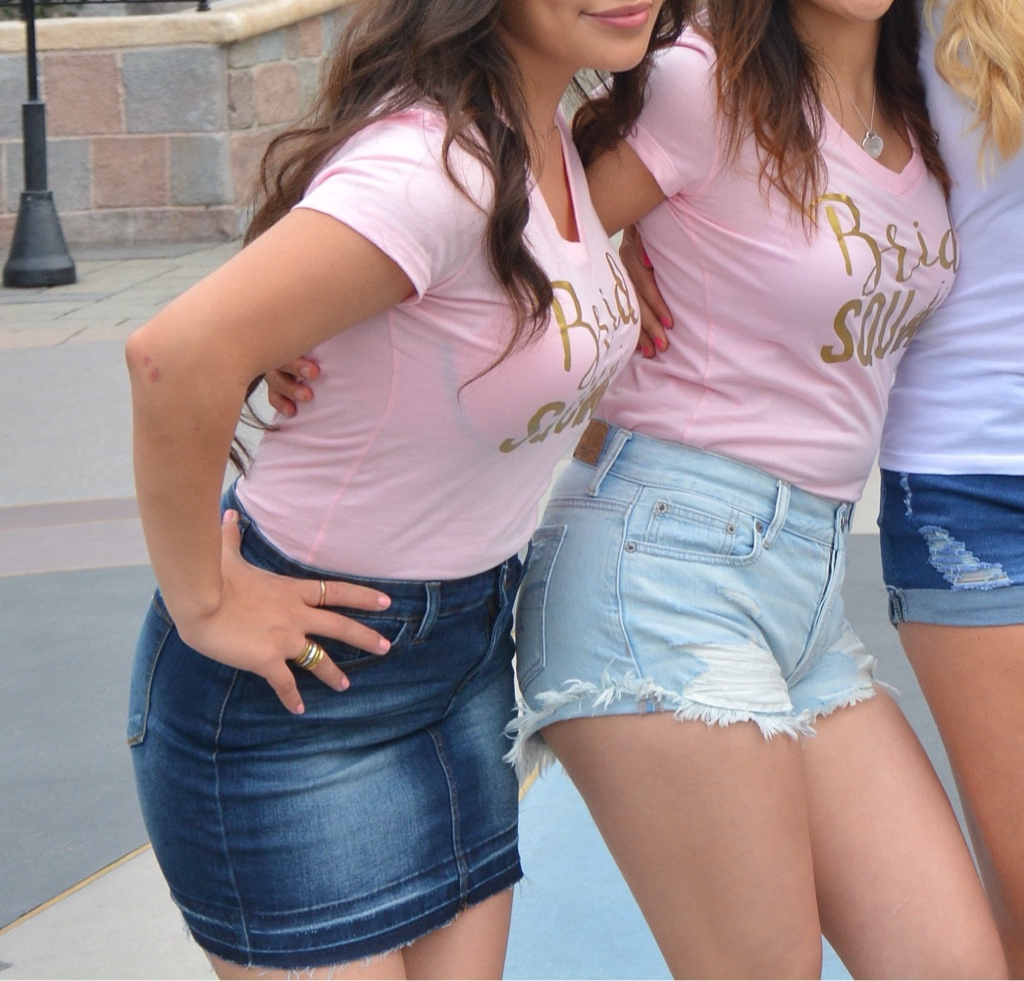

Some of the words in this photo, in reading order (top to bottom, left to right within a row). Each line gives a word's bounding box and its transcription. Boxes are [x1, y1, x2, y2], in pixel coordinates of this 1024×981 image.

[811, 193, 957, 296] Brid
[550, 252, 638, 390] Brid
[820, 281, 946, 366] SQU
